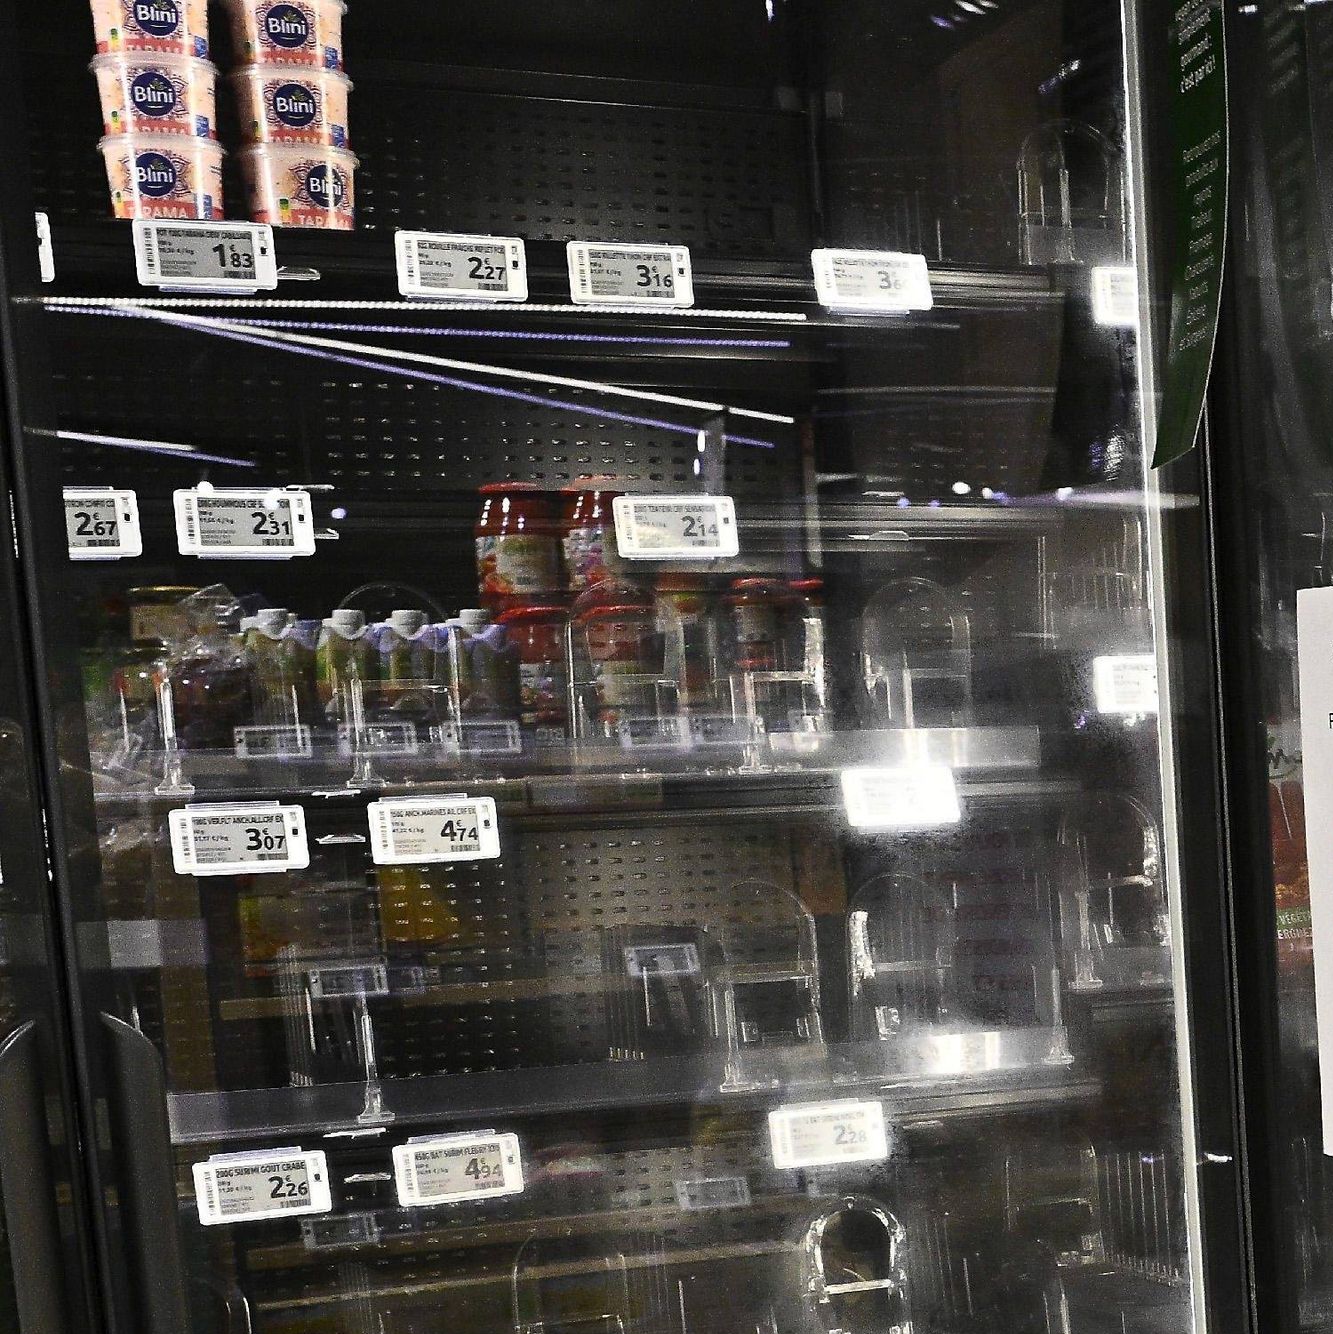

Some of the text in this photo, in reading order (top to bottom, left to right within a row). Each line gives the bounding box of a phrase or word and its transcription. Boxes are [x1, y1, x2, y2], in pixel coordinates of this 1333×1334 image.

[137, 4, 176, 22] Blini
[268, 18, 307, 36] Blini
[133, 85, 174, 103] Blini
[276, 97, 315, 114] Blini
[135, 166, 174, 183] Blini
[468, 256, 506, 280] 2€27
[637, 264, 672, 287] 3€16
[74, 512, 117, 535] 2€67
[252, 511, 290, 535] 2€31
[246, 828, 286, 851] 3€07
[440, 820, 479, 842] 4€74
[260, 1164, 280, 1175] GOUT
[269, 1175, 308, 1198] 2€26
